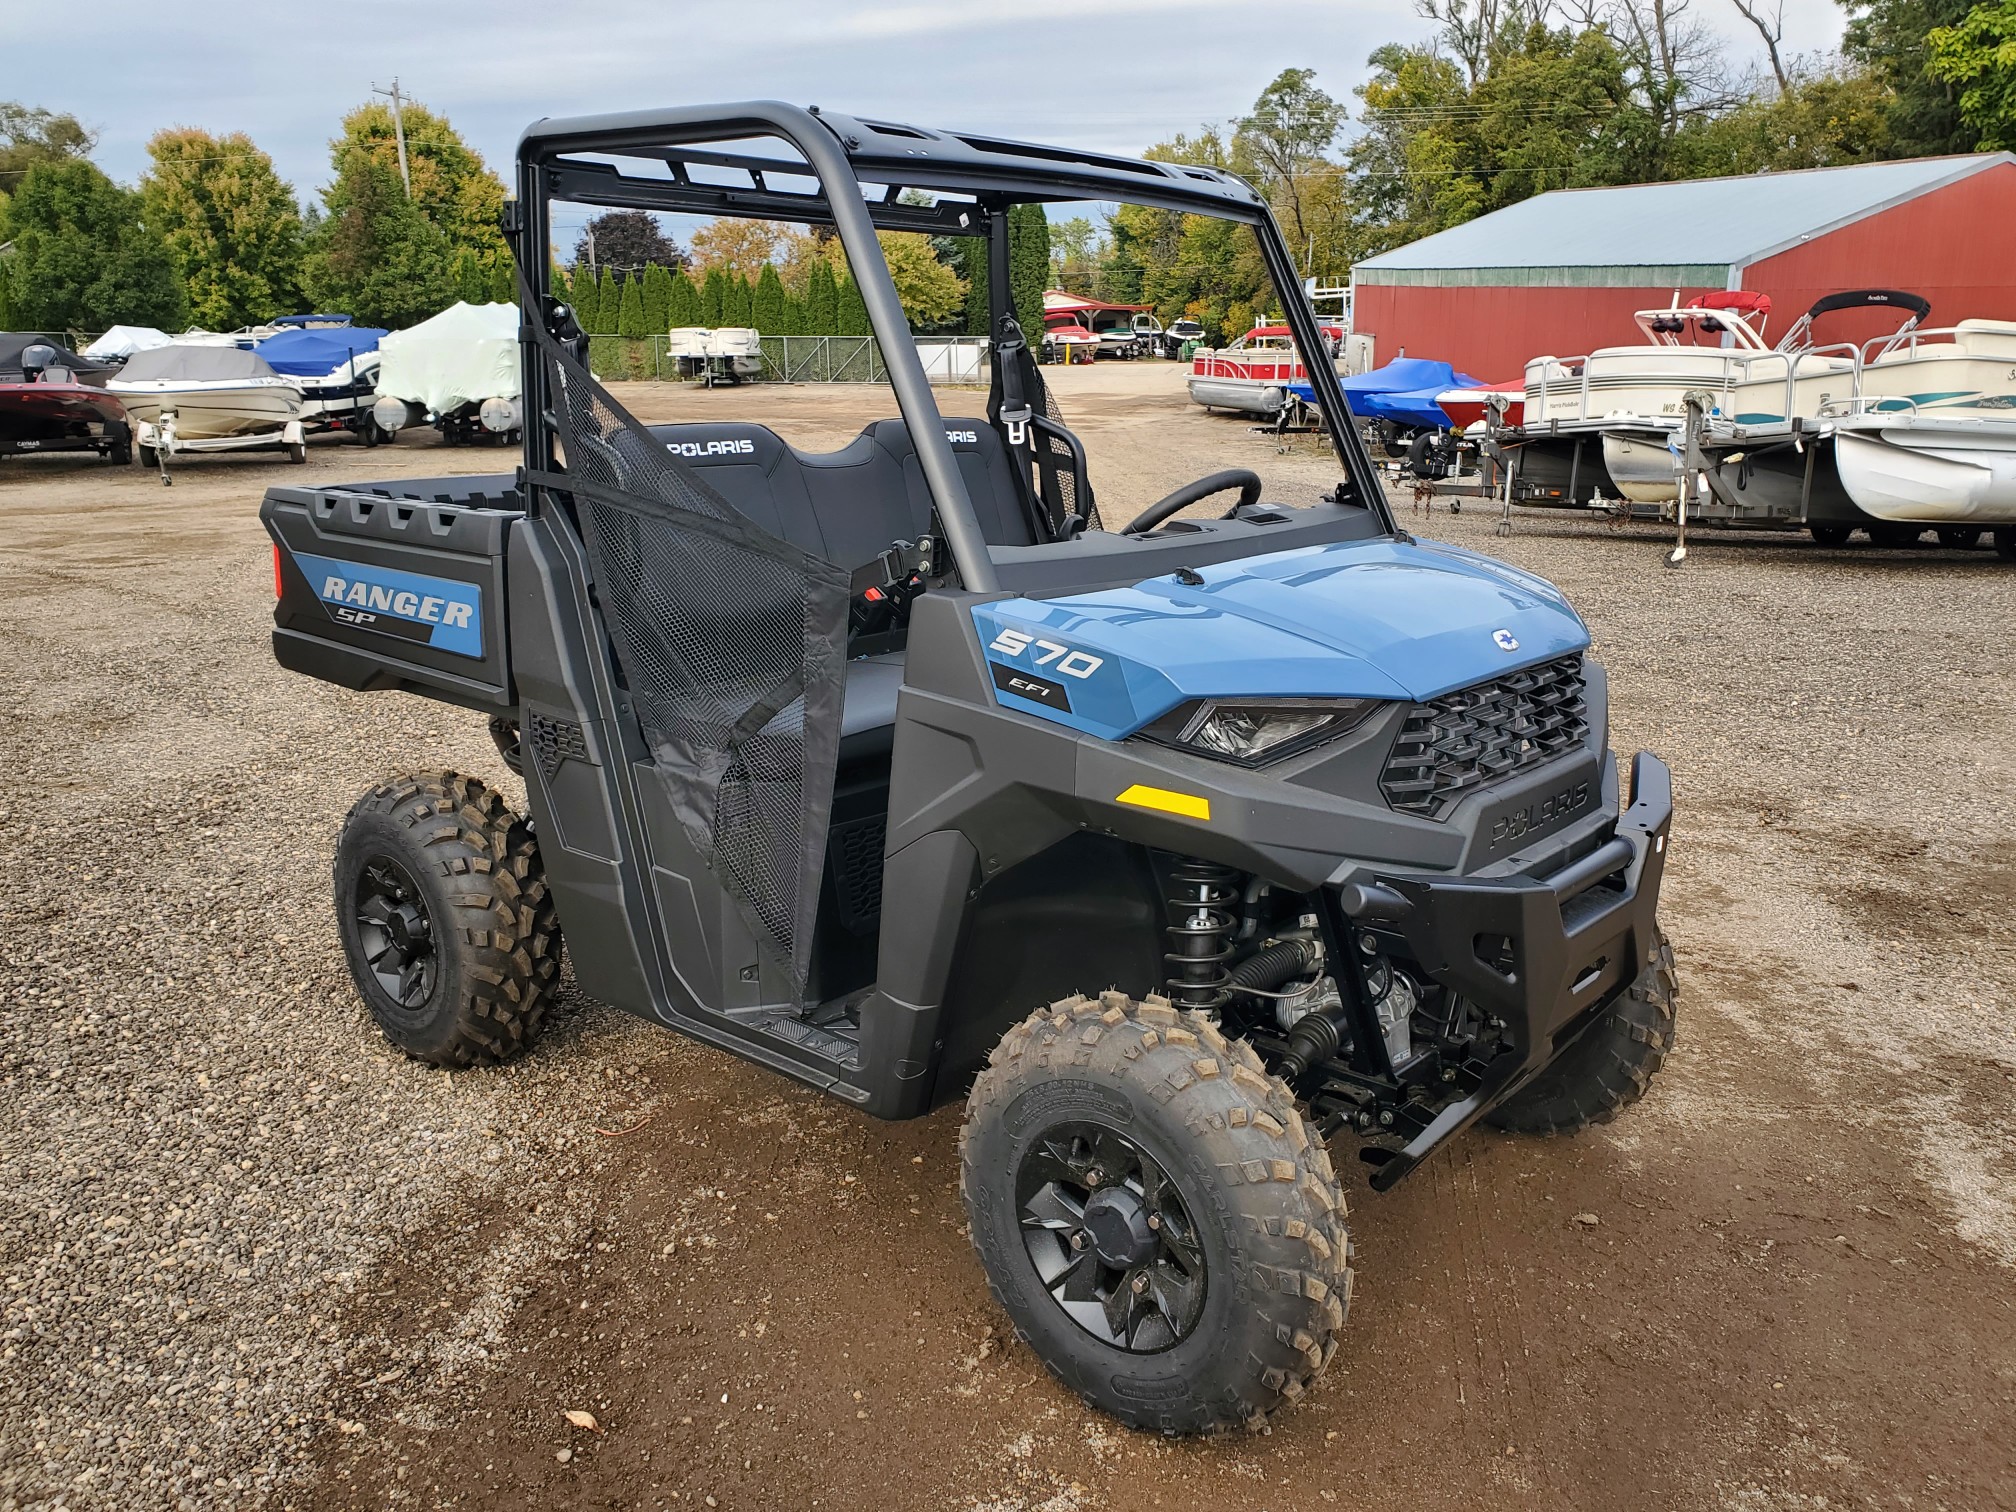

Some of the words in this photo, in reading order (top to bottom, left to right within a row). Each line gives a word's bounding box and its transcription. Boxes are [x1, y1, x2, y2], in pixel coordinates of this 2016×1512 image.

[1662, 403, 1676, 413] WS
[945, 430, 977, 443] ARIS
[666, 439, 755, 457] POLARIS
[323, 576, 473, 629] RANGER
[335, 607, 377, 624] SP
[989, 628, 1104, 680] 570
[1008, 677, 1050, 697] EFI
[1489, 782, 1588, 850] POLARIS
